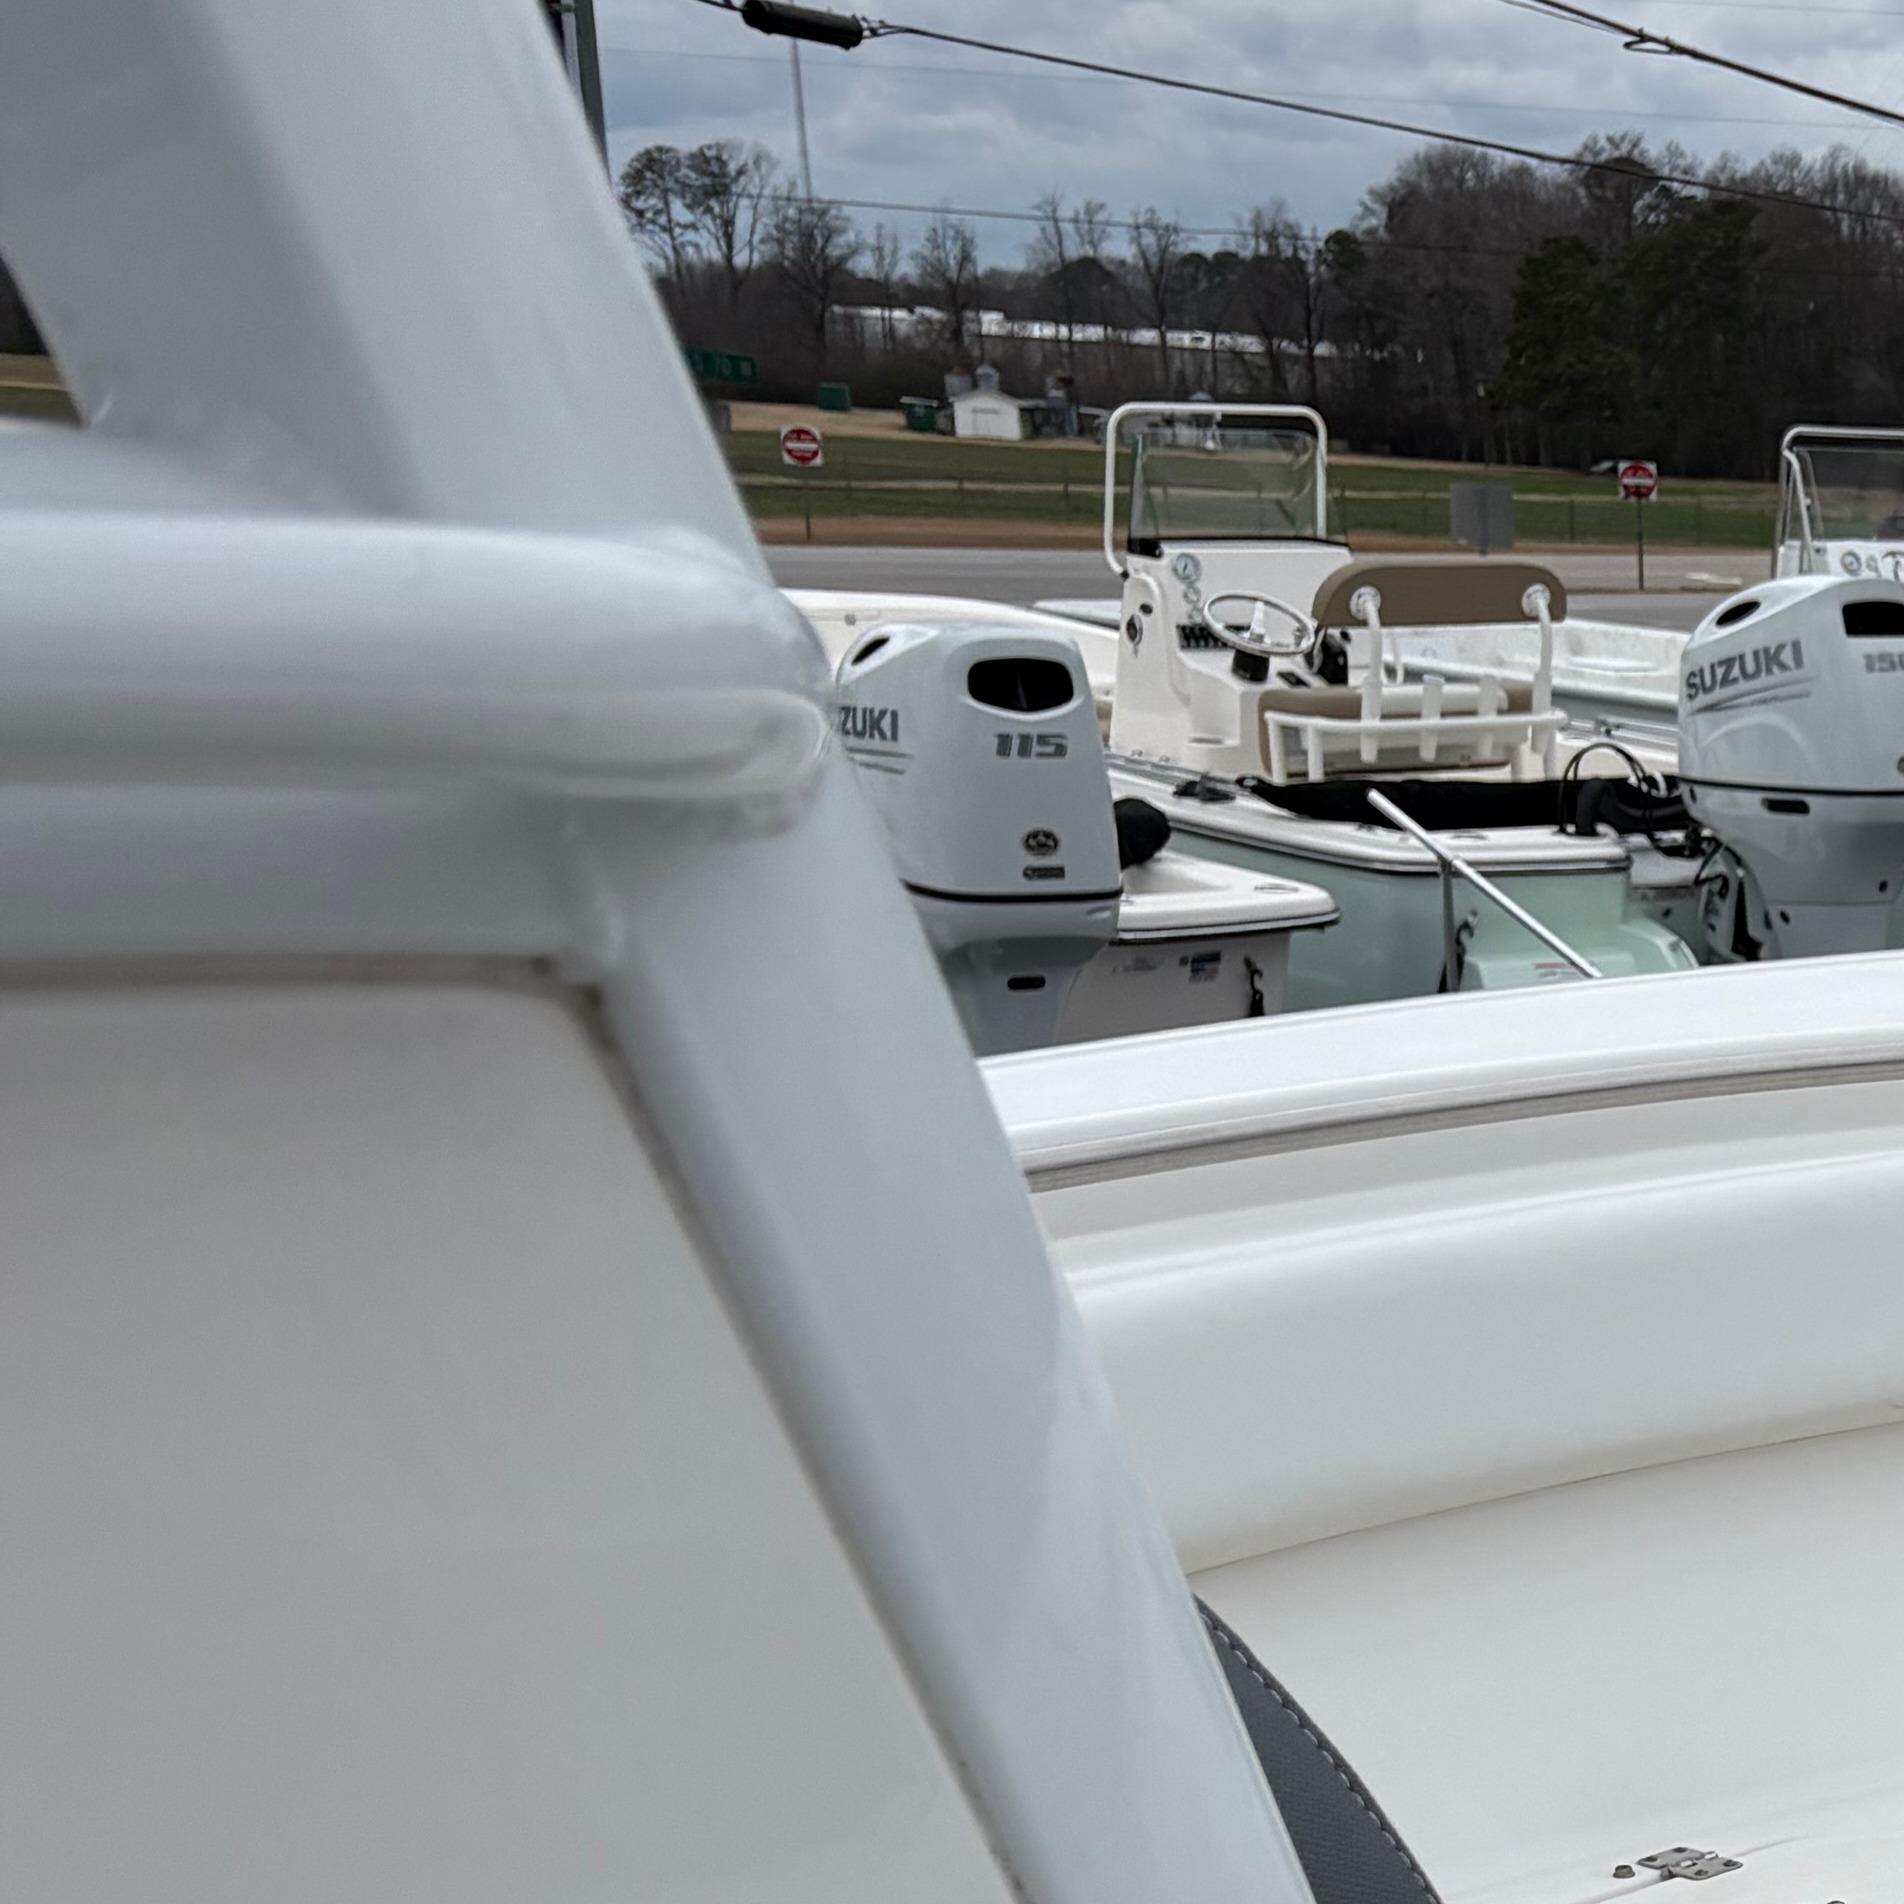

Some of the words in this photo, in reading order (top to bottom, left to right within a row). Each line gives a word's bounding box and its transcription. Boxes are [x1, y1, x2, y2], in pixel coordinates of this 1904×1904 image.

[1685, 640, 1805, 702] SUZUKI
[840, 706, 899, 742] ZUKI
[994, 733, 1069, 758] 115
